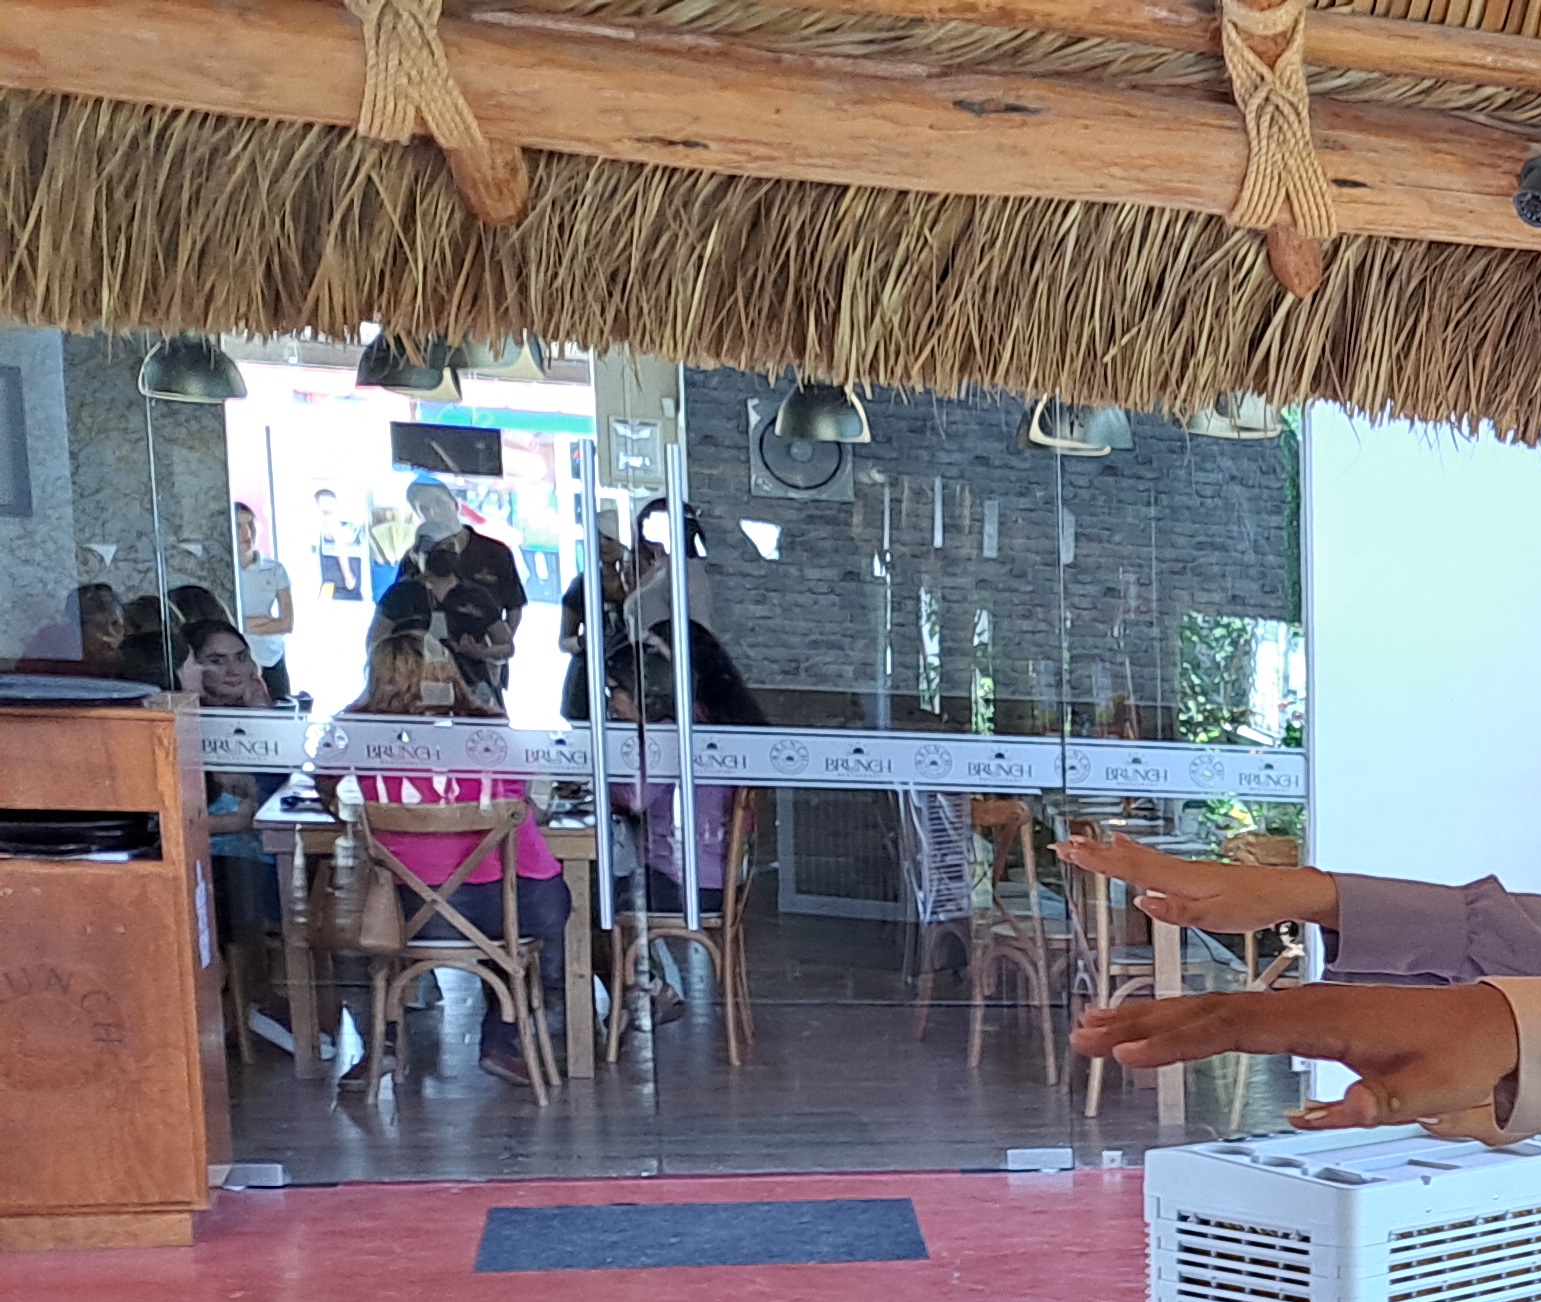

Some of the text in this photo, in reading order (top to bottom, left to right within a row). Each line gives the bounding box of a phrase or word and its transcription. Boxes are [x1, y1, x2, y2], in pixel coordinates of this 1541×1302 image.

[202, 738, 279, 756] BRUNCH
[825, 757, 892, 774] BRUNCH
[967, 762, 1033, 778] BRUNCH
[1105, 767, 1168, 782] BRUNCH
